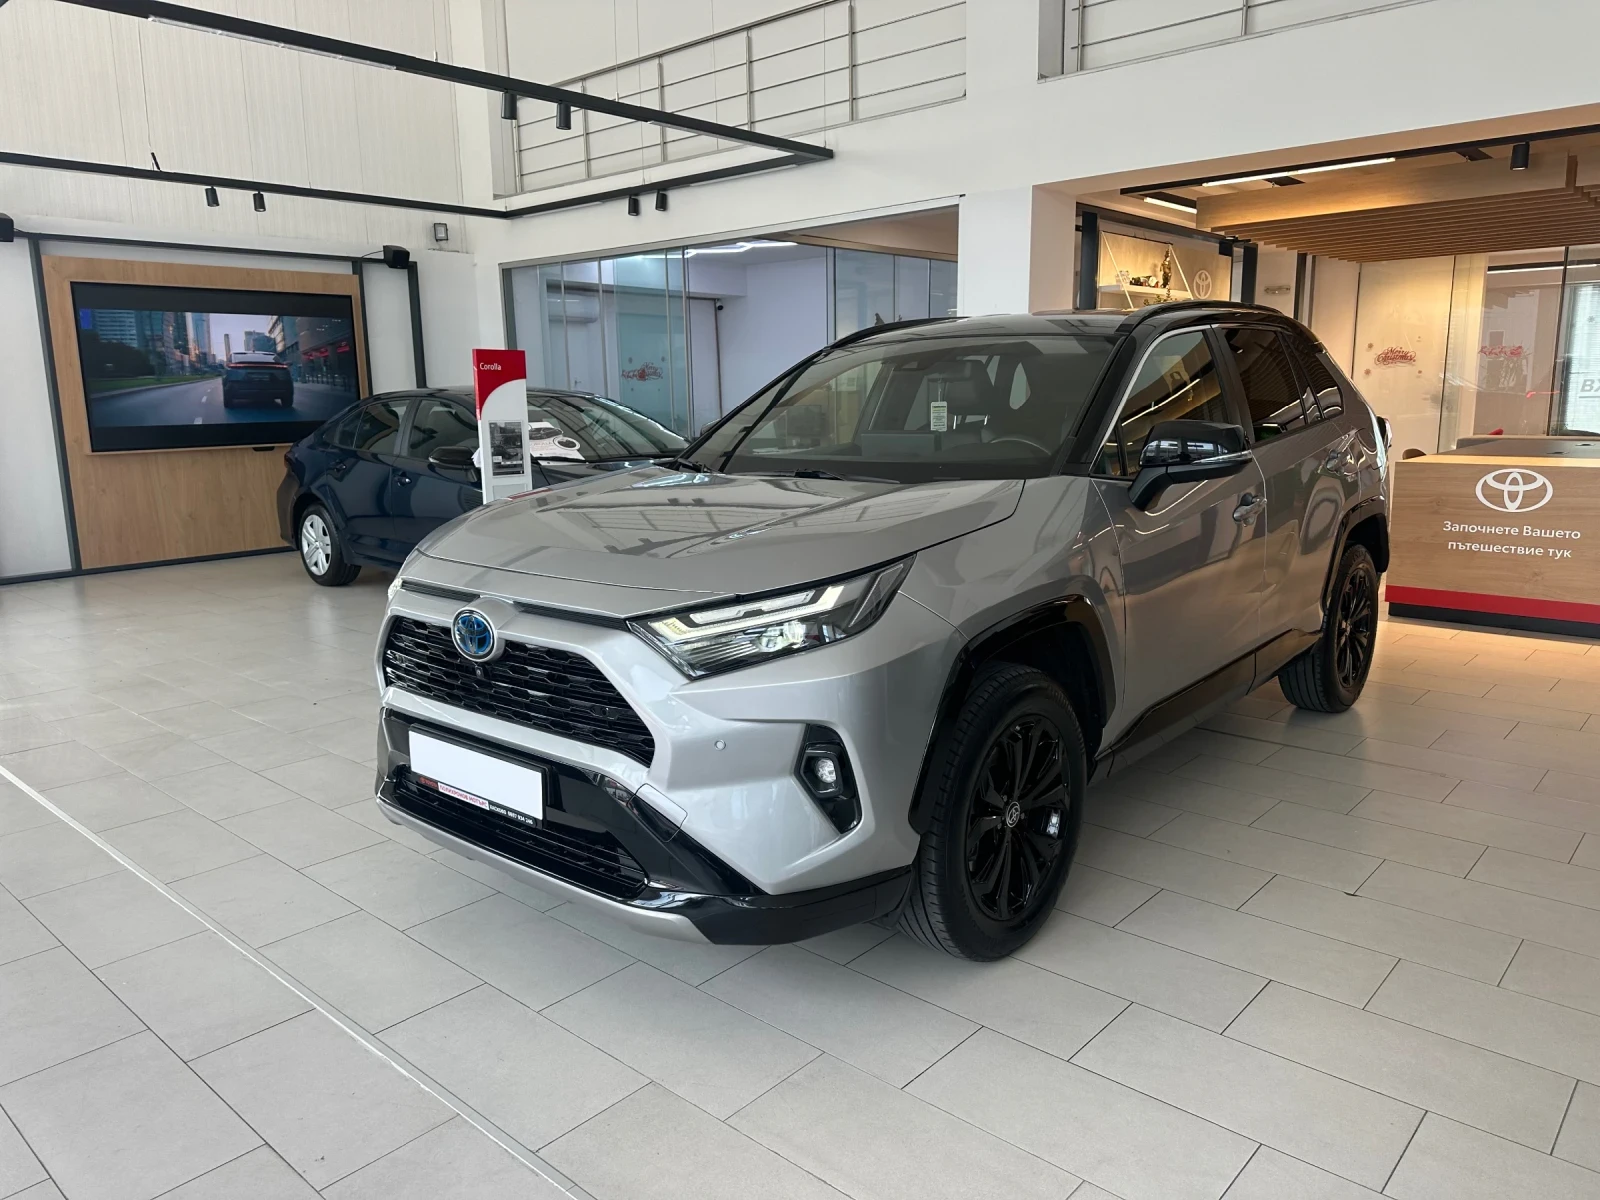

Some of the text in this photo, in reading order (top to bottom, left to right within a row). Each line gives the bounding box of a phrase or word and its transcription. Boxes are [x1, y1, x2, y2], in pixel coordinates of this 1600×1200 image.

[479, 362, 502, 371] Corolla
[1442, 520, 1581, 540] Започнете Вашето
[1447, 541, 1572, 560] пътешествие тук
